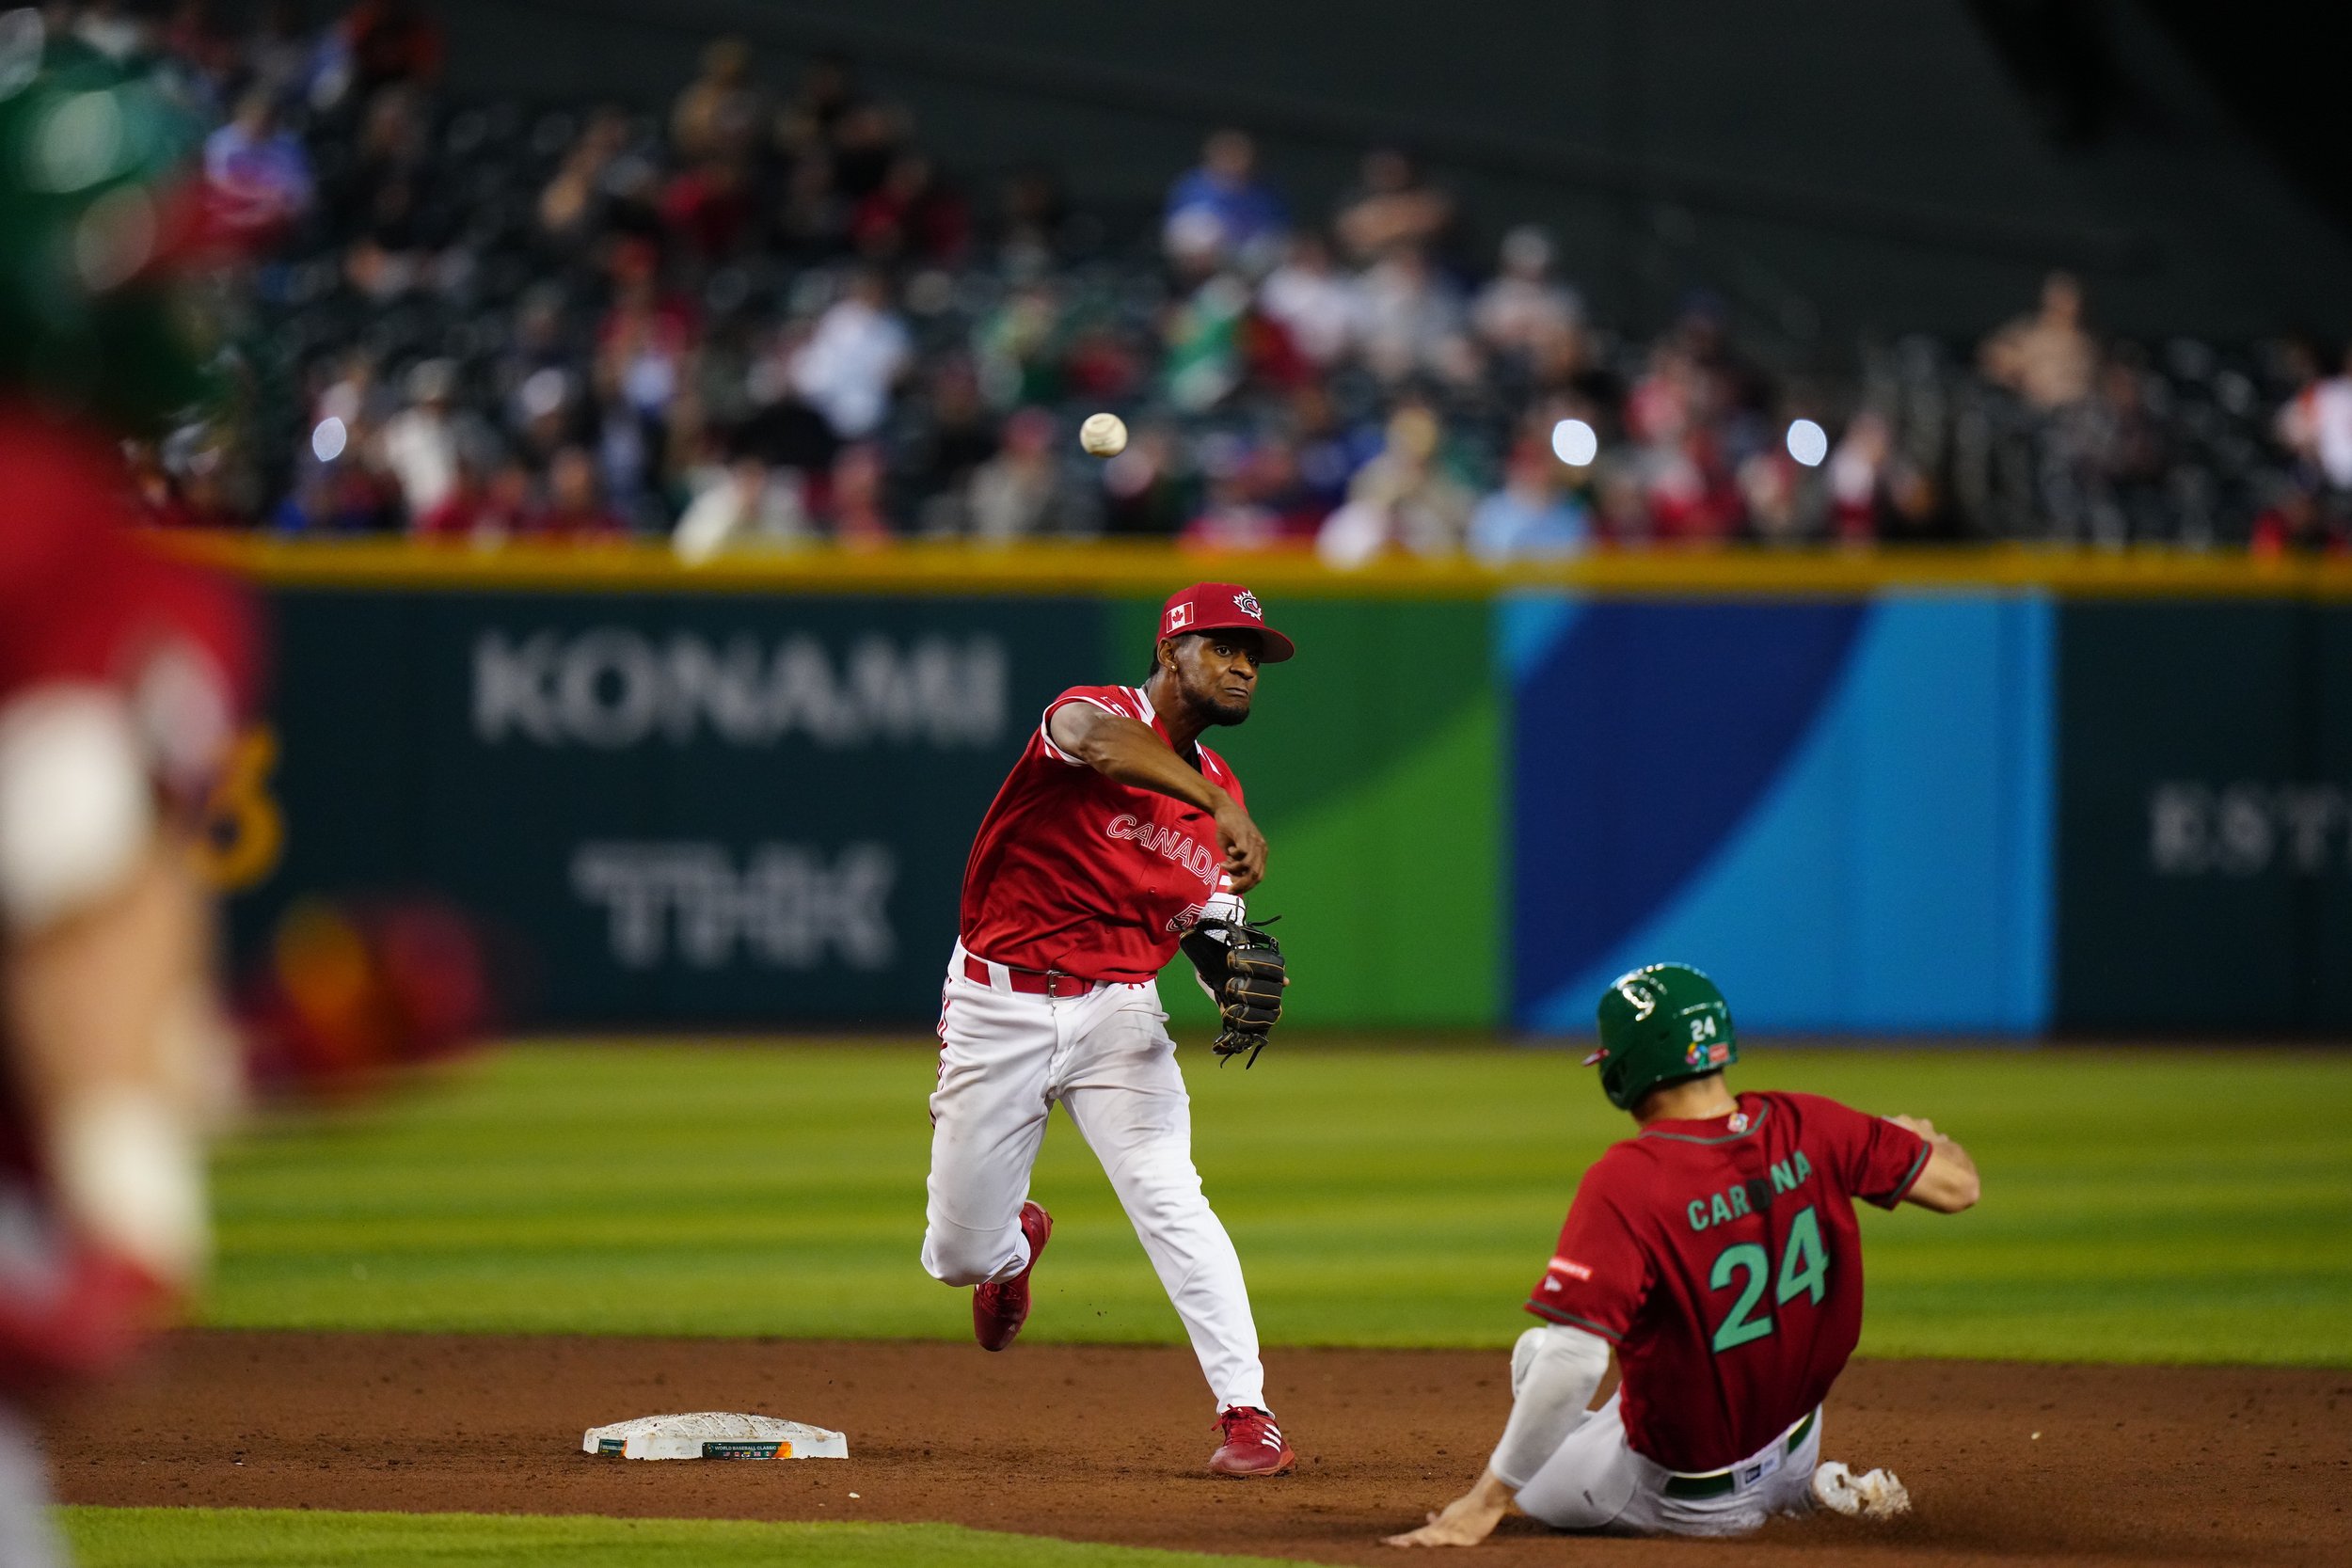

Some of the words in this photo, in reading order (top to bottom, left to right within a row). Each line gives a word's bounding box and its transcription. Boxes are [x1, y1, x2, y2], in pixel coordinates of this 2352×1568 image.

[476, 629, 1007, 750] KONAMI
[1106, 814, 1221, 895] CANADA
[2149, 782, 2352, 875] EST
[1690, 1015, 1717, 1042] 24
[1709, 1204, 1830, 1354] 24
